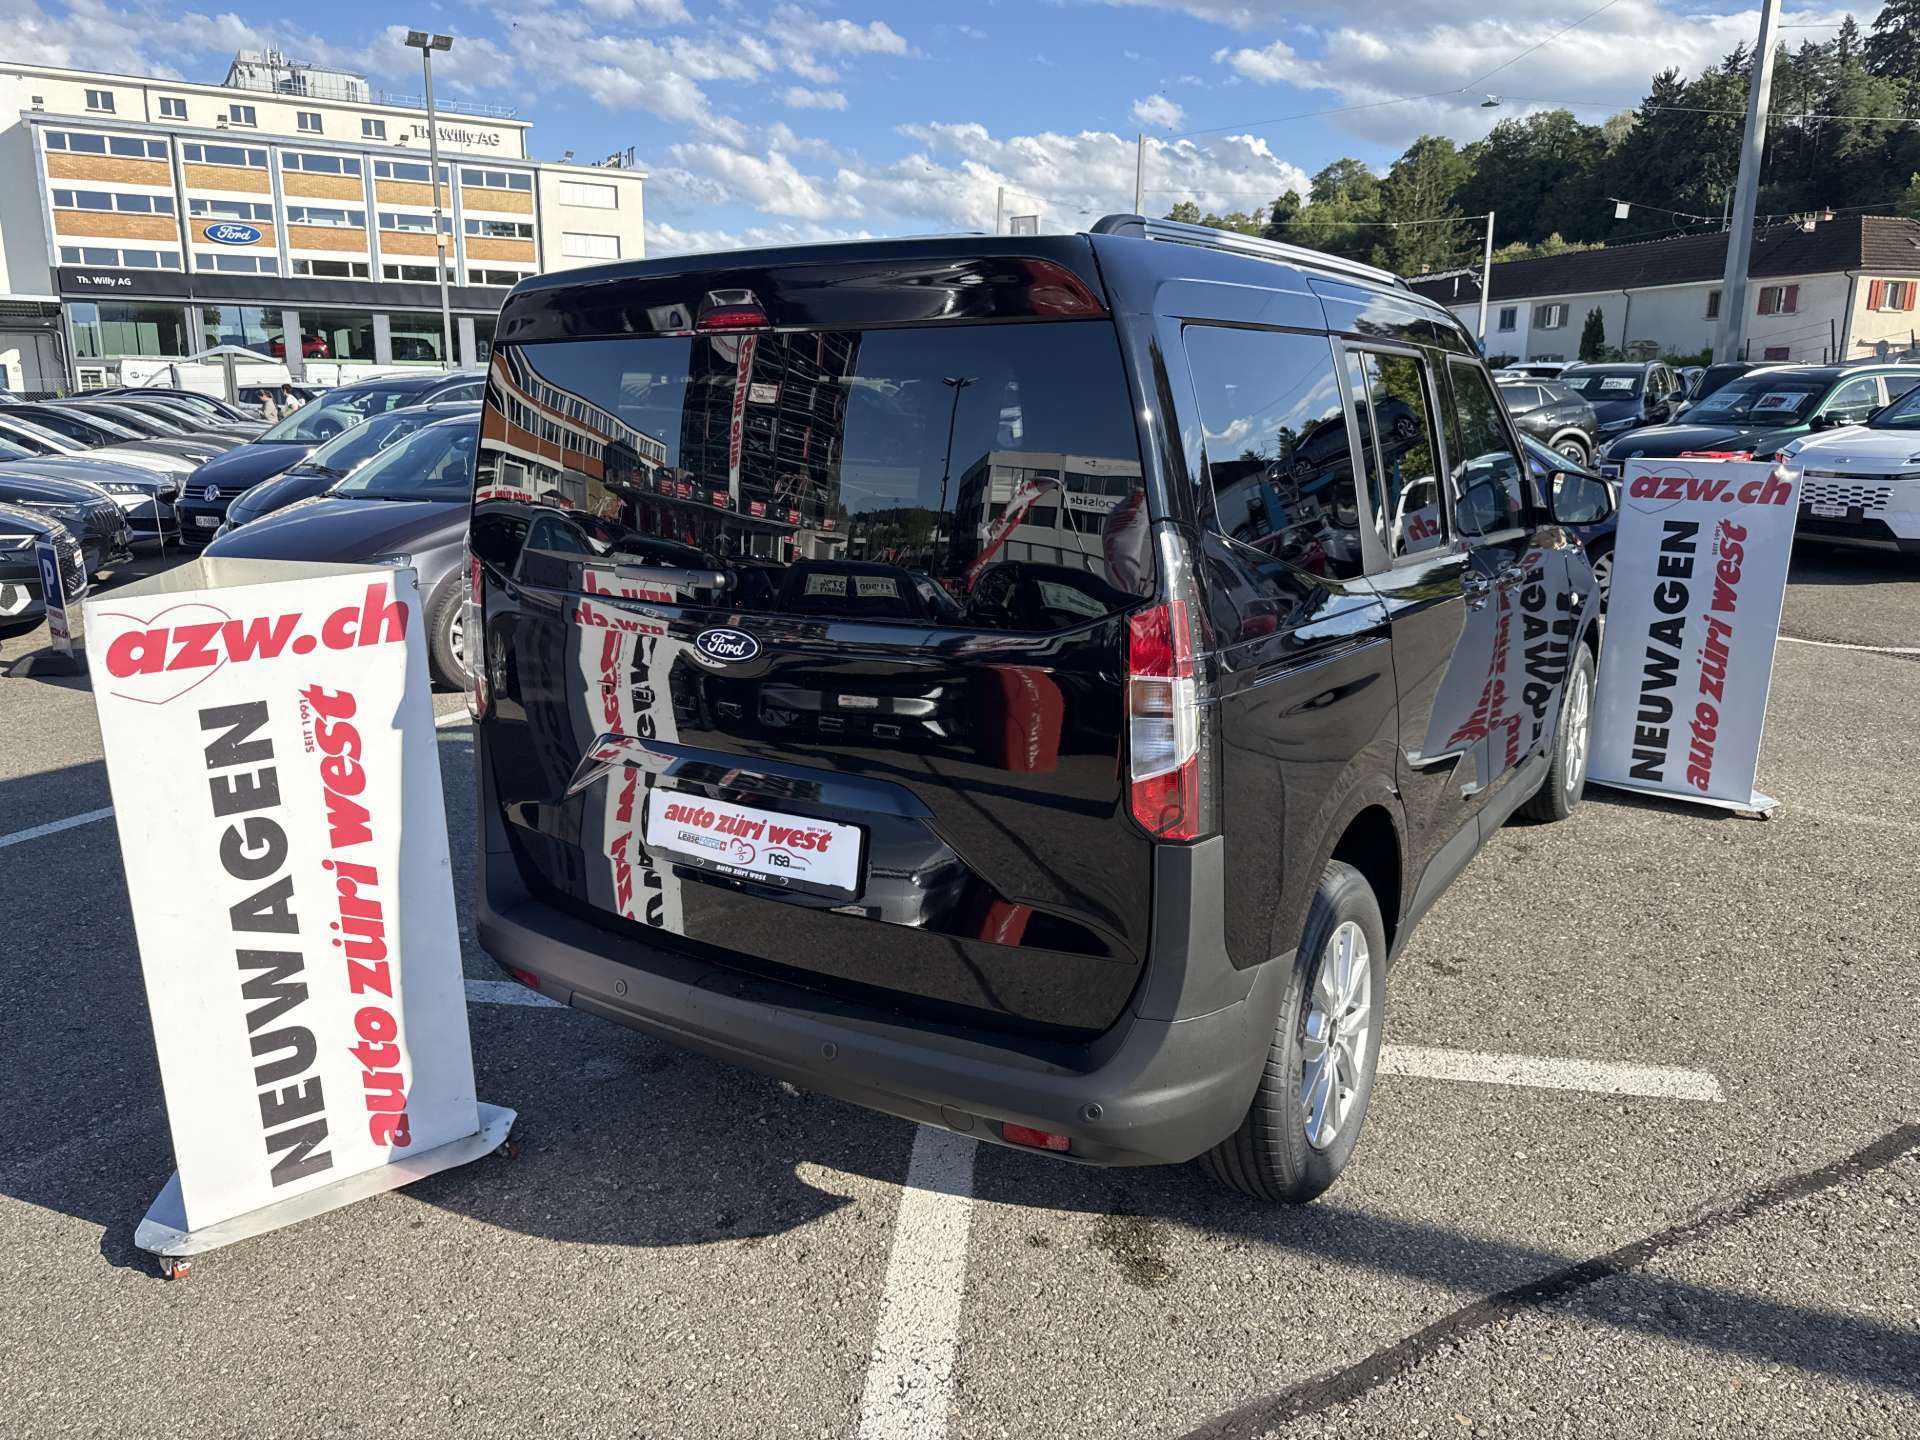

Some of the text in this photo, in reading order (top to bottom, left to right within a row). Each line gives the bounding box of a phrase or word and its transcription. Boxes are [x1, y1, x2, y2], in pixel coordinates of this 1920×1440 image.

[410, 124, 500, 147] Th Willy AG
[76, 275, 131, 287] Th. Willy AG
[1629, 472, 1792, 505] azw.ch
[42, 559, 55, 598] P
[106, 582, 410, 678] azw.ch
[1629, 520, 1700, 782] NEUWAGEN
[1686, 518, 1747, 791] auto züri west
[299, 699, 315, 753] SEIT 1991
[664, 803, 832, 853] auto züri west
[716, 864, 732, 873] auto
[750, 871, 767, 881] west
[768, 853, 790, 868] nsa
[298, 684, 411, 1147] auto züri west
[199, 700, 332, 1187] NEUWAGEN
